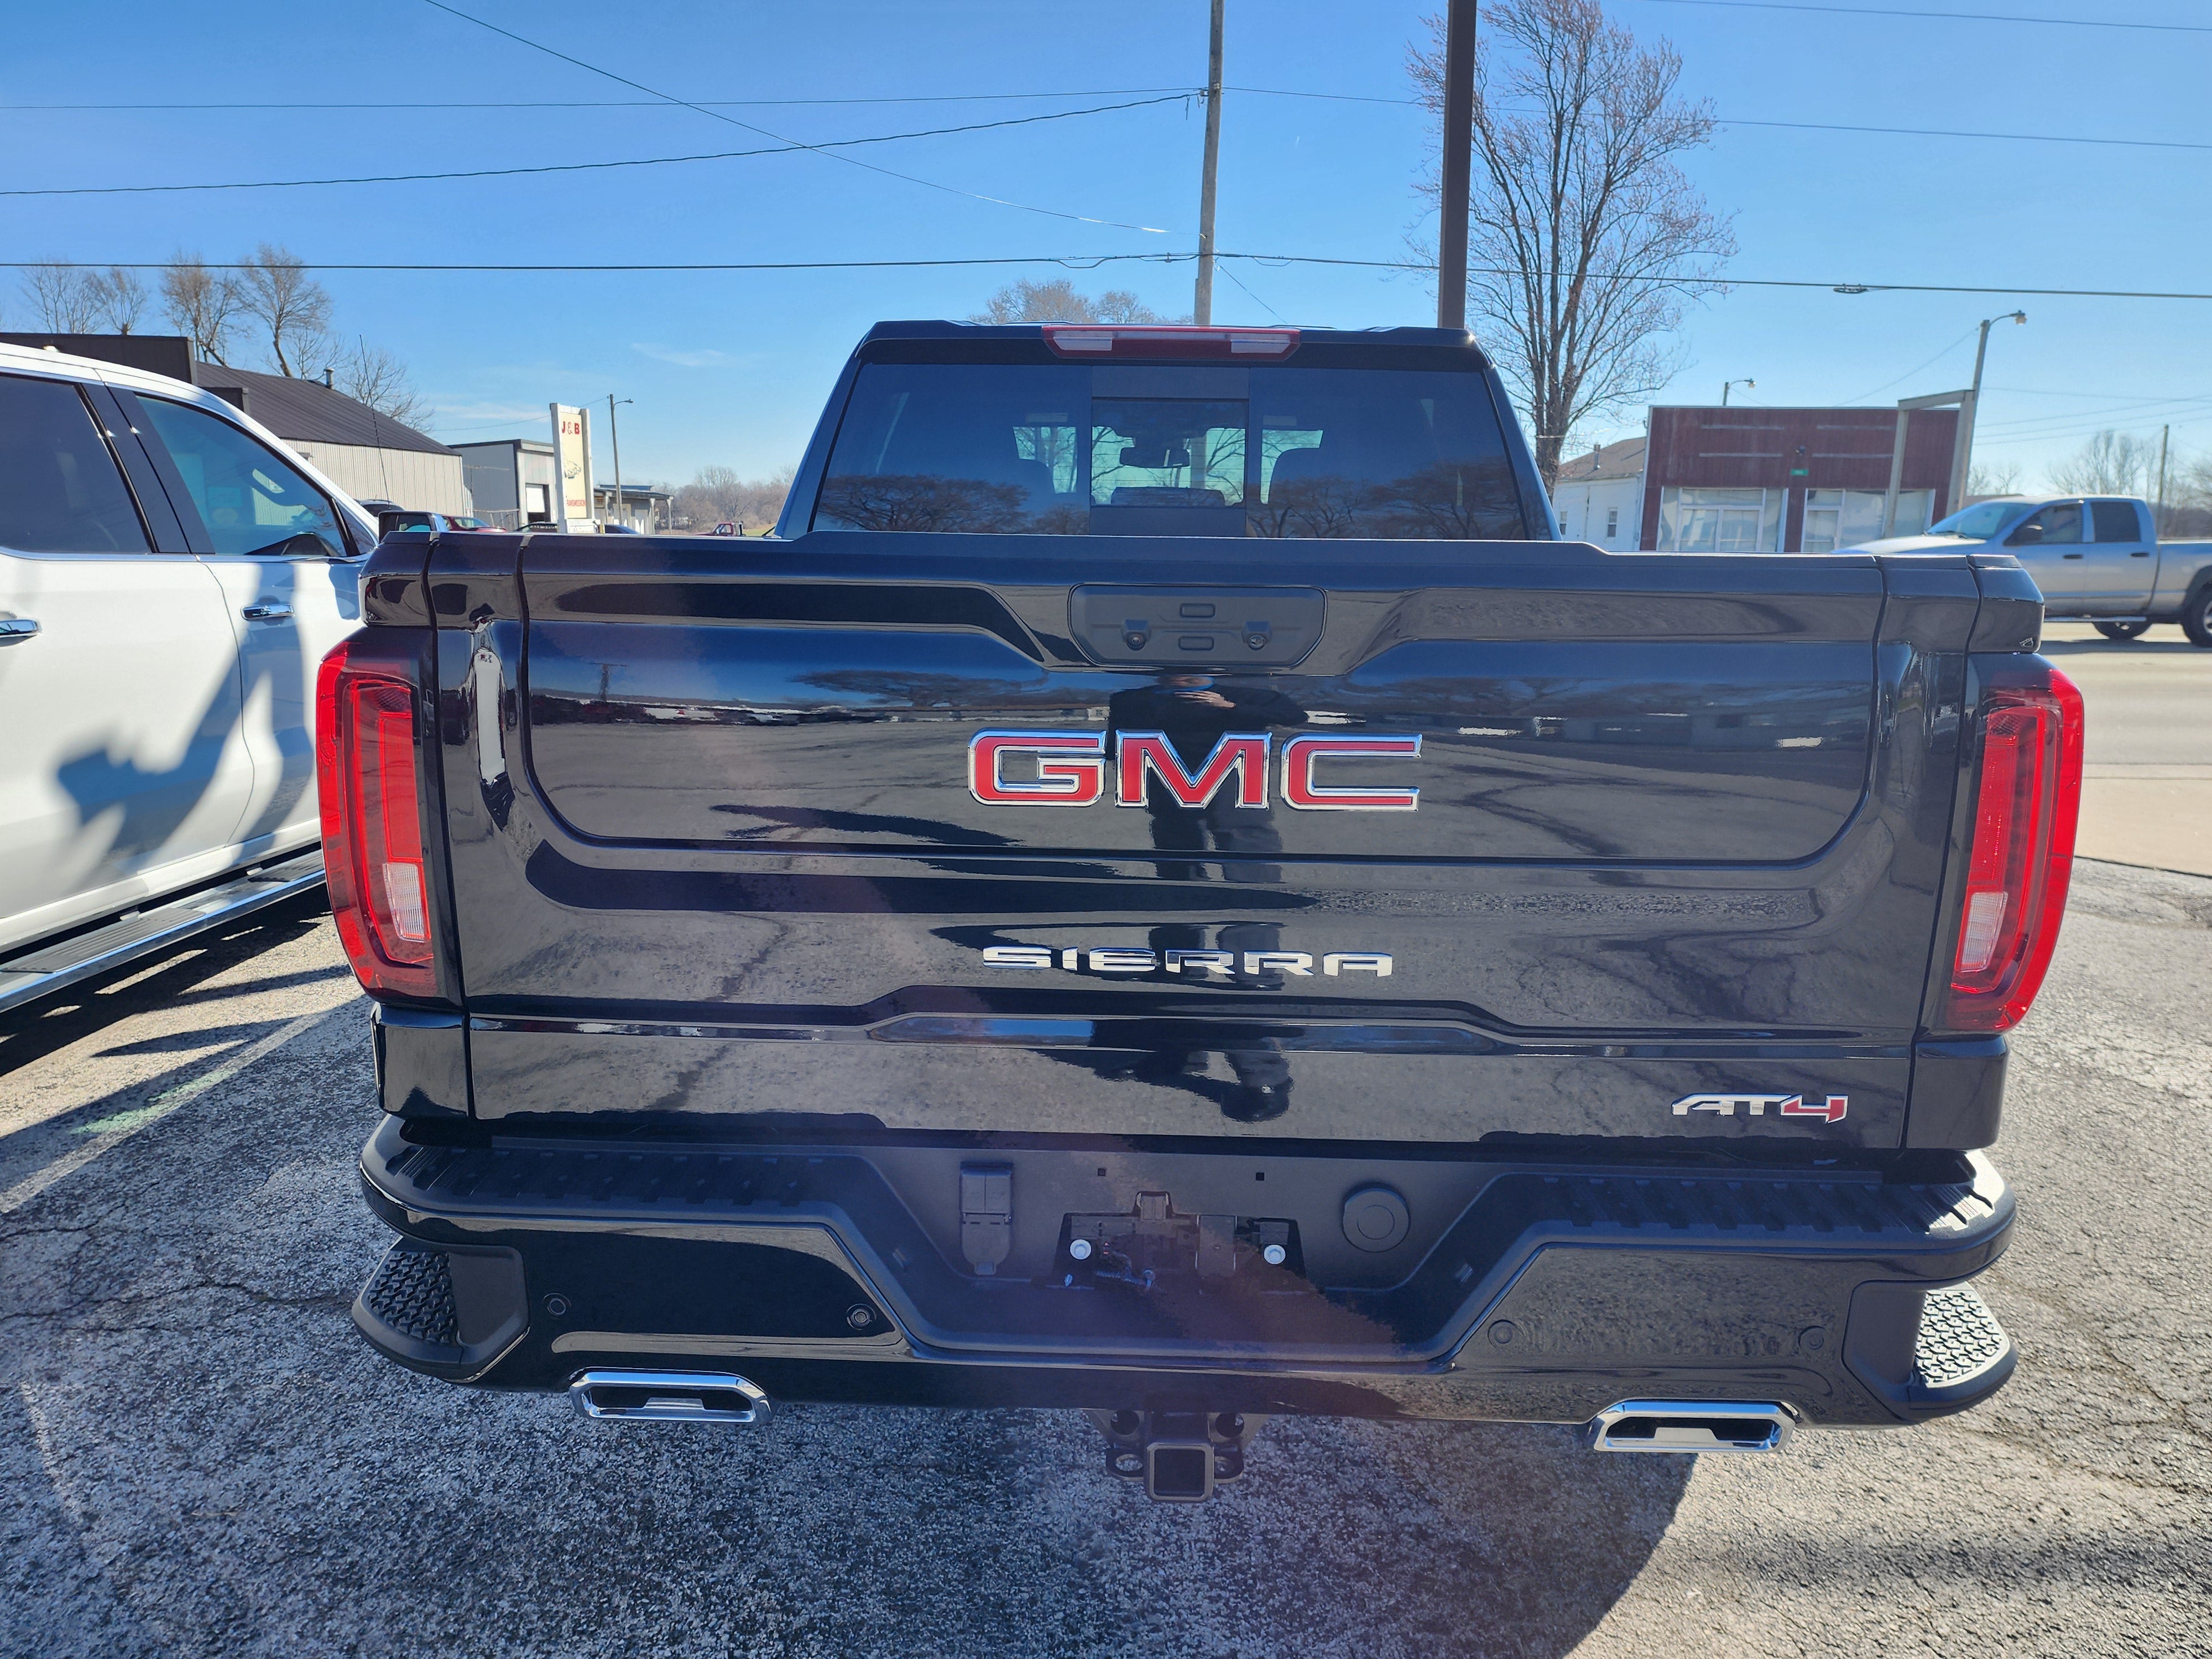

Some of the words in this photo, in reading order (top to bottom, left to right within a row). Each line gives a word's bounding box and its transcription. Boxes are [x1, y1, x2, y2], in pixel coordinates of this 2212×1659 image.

[561, 421, 565, 434] J
[574, 422, 580, 435] B
[967, 728, 1423, 812] GMC
[982, 945, 1393, 977] SIERRA
[1672, 1093, 1849, 1124] AT4
